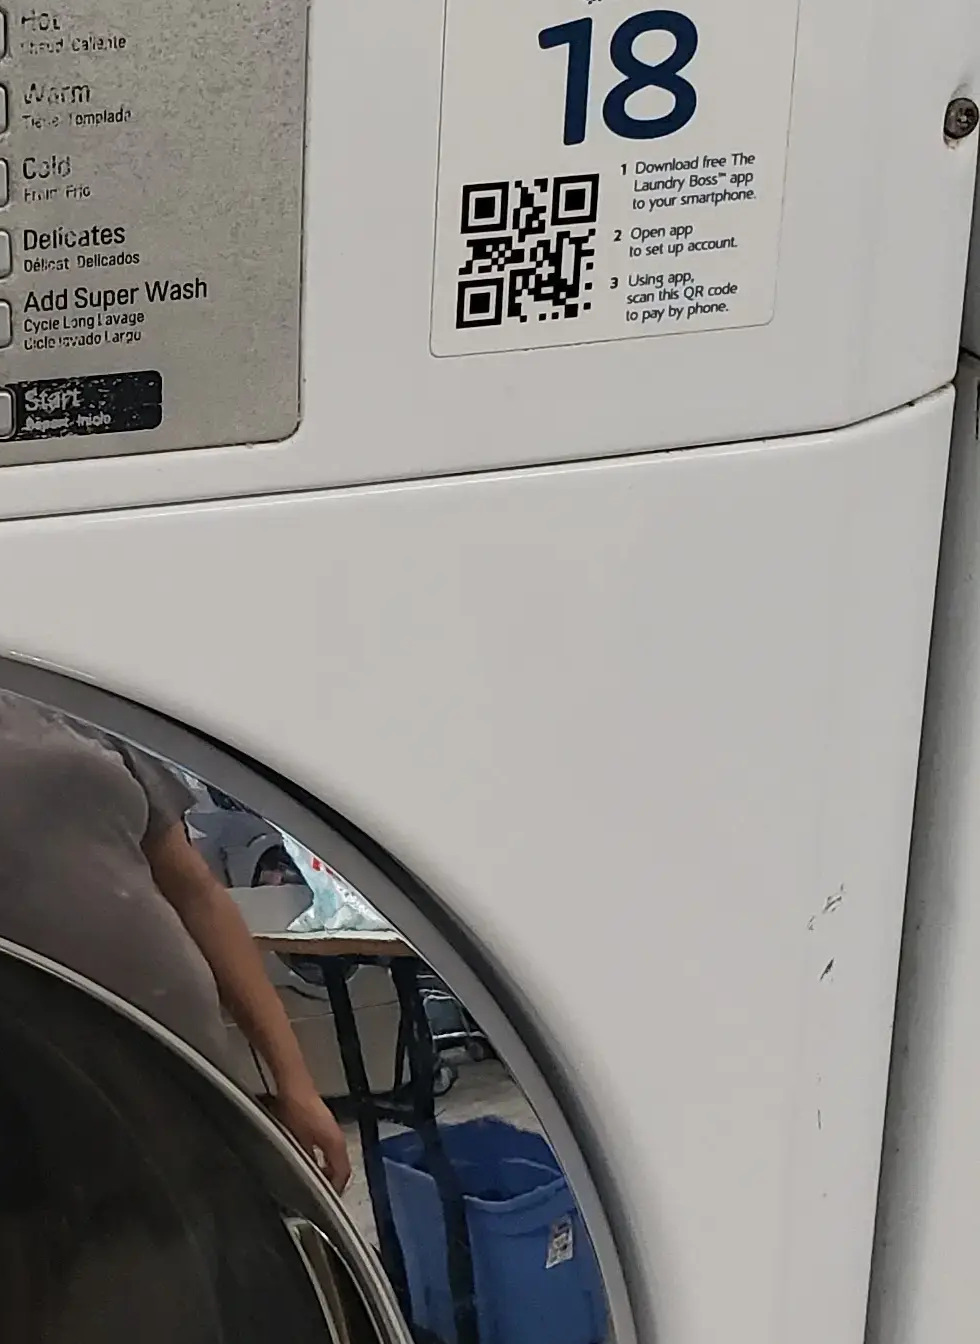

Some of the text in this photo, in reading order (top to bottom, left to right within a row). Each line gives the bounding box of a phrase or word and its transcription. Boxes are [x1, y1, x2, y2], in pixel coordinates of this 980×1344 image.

[538, 9, 698, 146] 18
[23, 155, 71, 180] Cold
[620, 152, 755, 175] 1 Download free The
[633, 175, 685, 192] Laundry
[729, 172, 753, 187] app
[632, 188, 756, 212] to your smartphone.
[23, 225, 125, 251] Delicates
[613, 225, 693, 243] 2 Open app
[76, 251, 139, 268] Delicados
[629, 246, 641, 257] to
[645, 243, 663, 256] set
[667, 242, 683, 257] up
[609, 276, 618, 289] 3
[628, 273, 663, 289] Using
[626, 281, 737, 304] scan this QR code
[23, 276, 207, 313] Add Super Wash
[626, 301, 728, 323] to pay by phone.
